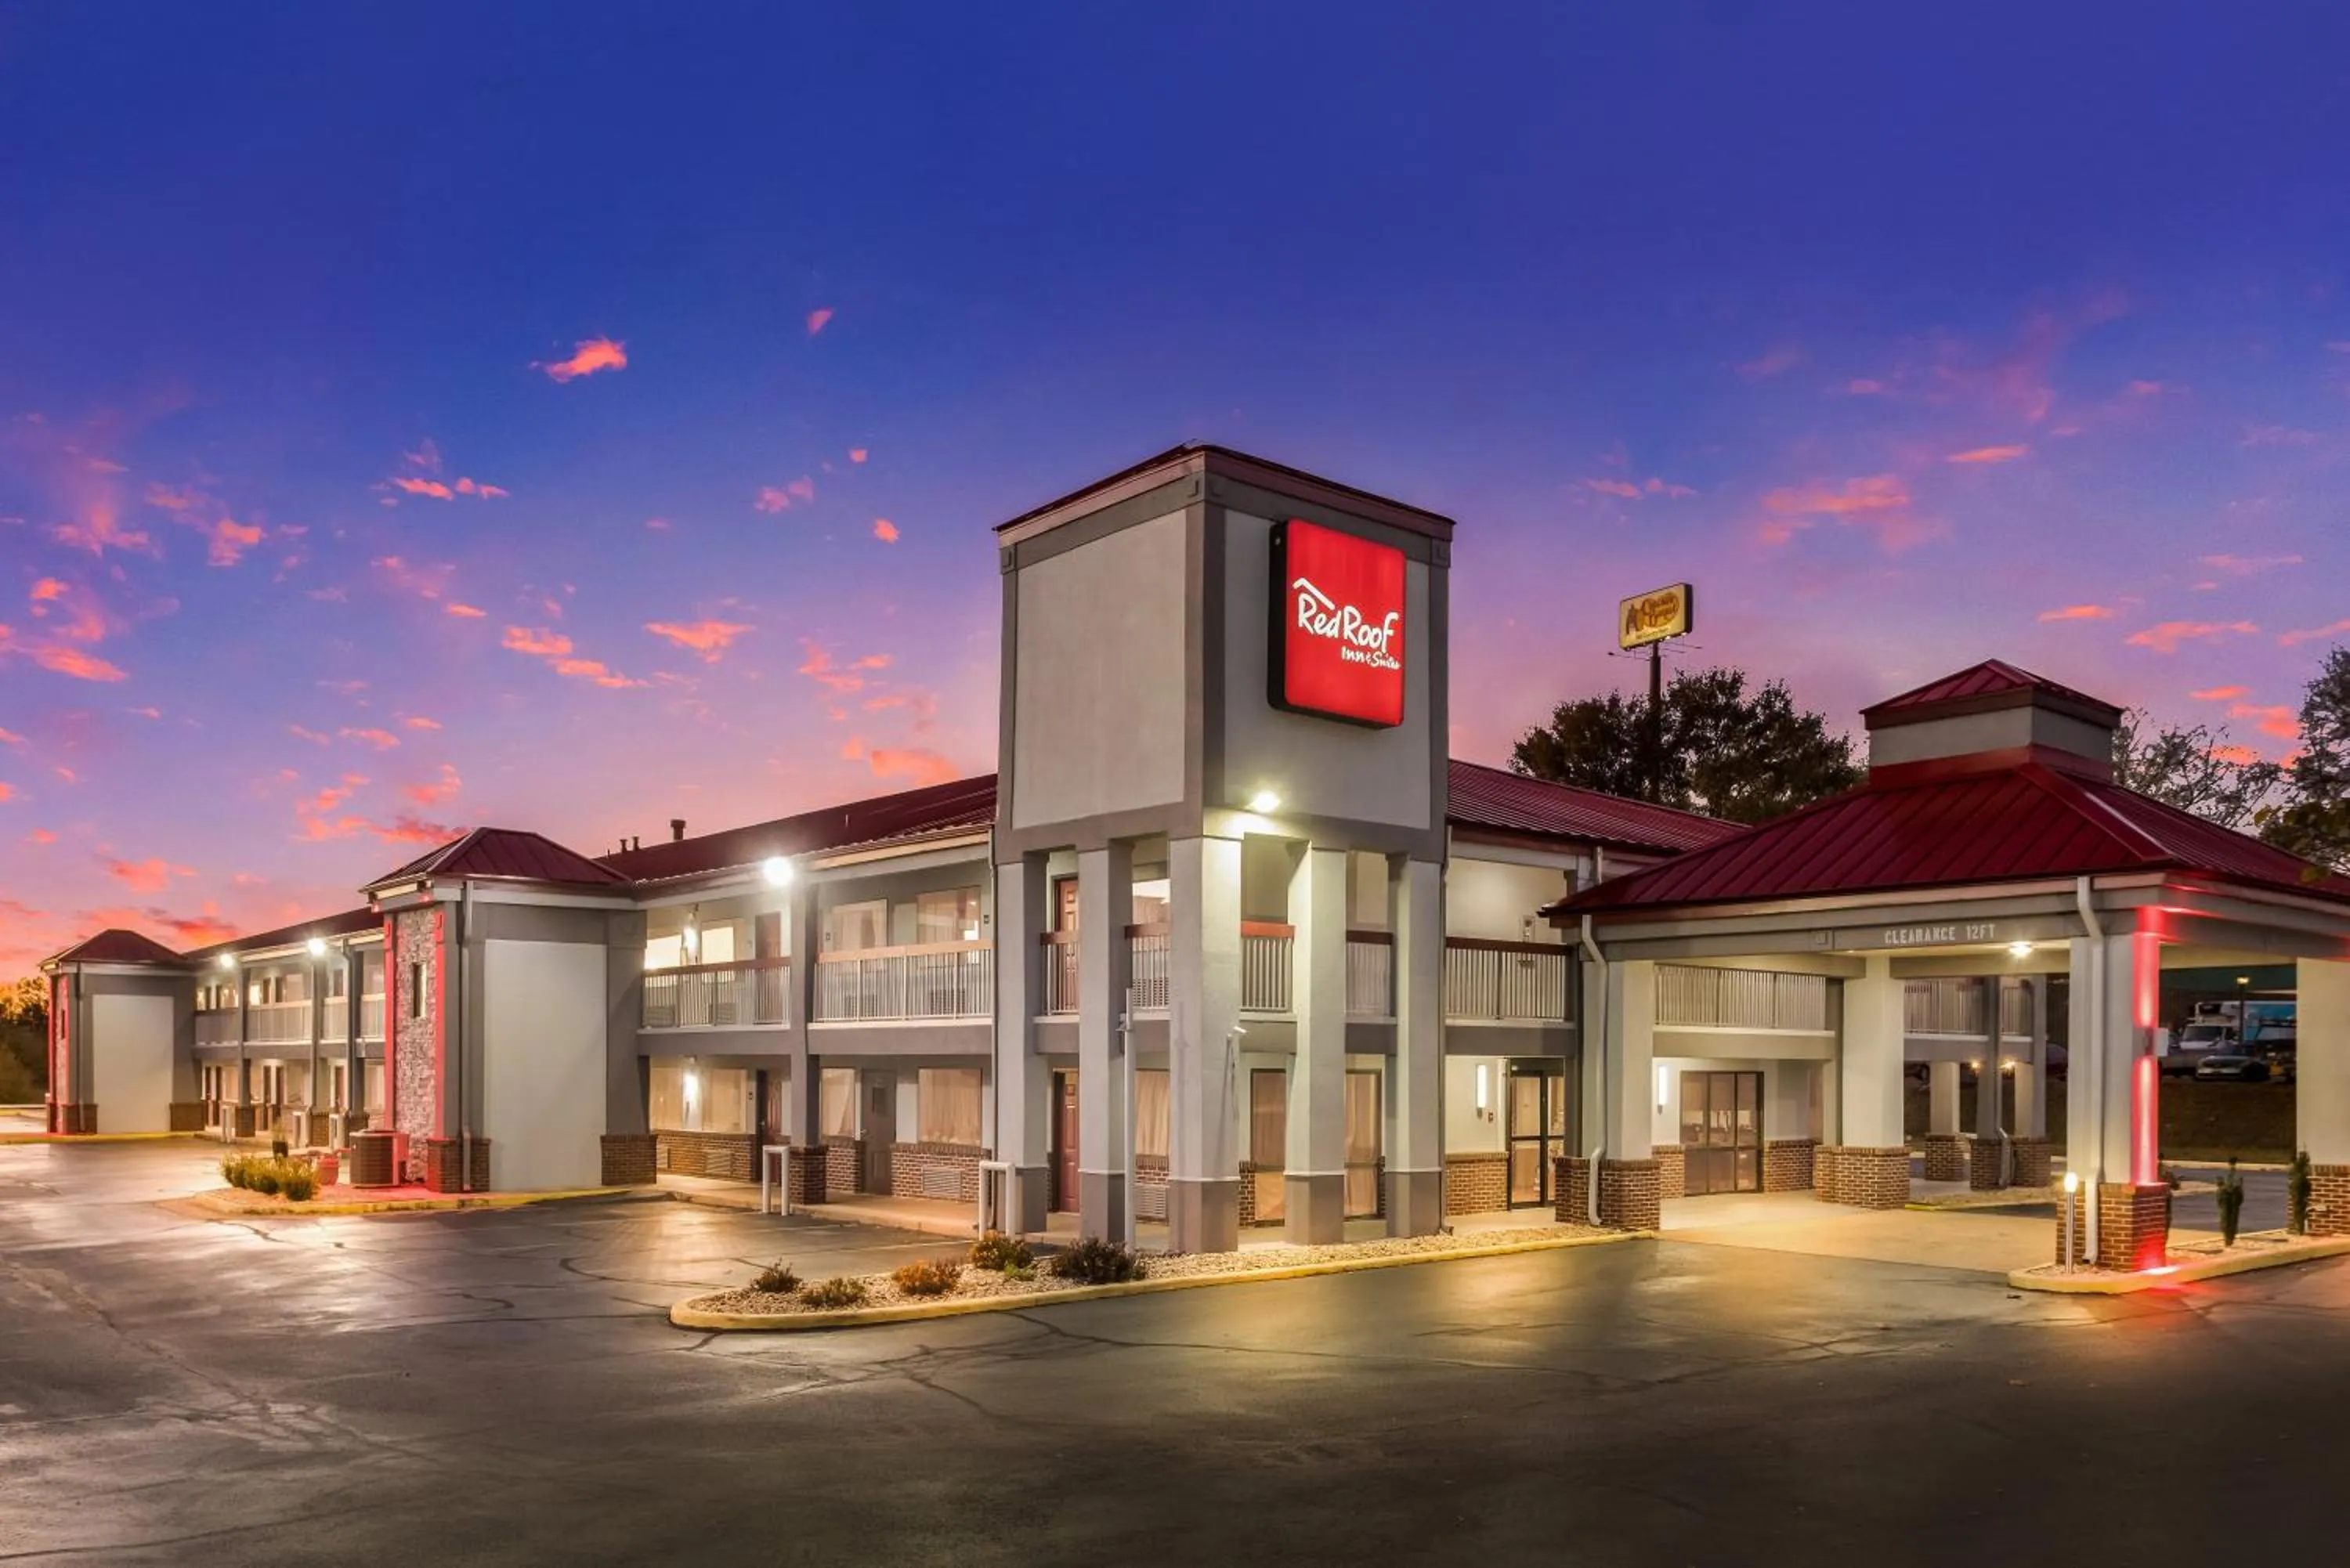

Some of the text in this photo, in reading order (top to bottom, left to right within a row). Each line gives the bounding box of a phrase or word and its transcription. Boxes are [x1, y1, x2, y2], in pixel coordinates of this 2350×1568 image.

[1297, 593, 1399, 653] Red Roof
[1884, 927, 1956, 944] CLEARANCE
